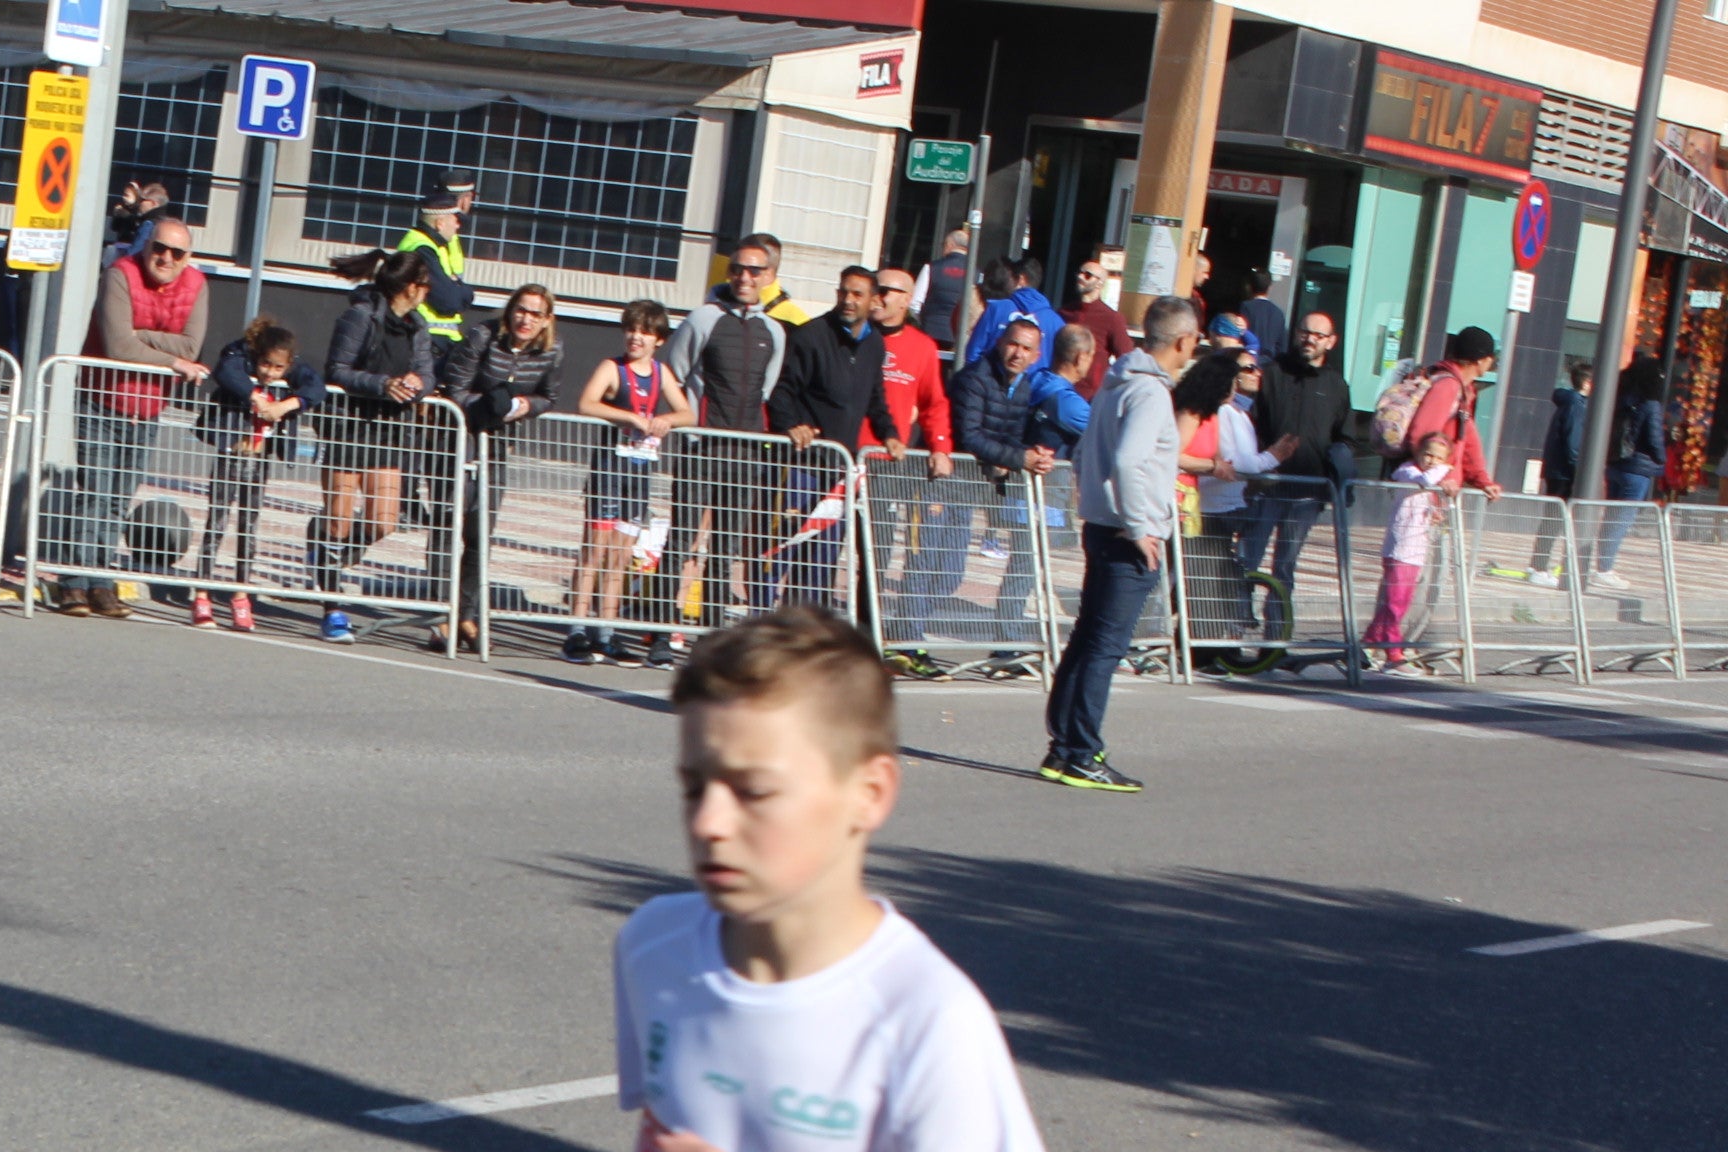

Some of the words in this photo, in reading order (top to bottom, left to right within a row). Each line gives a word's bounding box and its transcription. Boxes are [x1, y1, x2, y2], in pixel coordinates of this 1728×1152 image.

[249, 66, 296, 126] P
[931, 143, 963, 157] Pasaje
[912, 164, 966, 180] Auditorio
